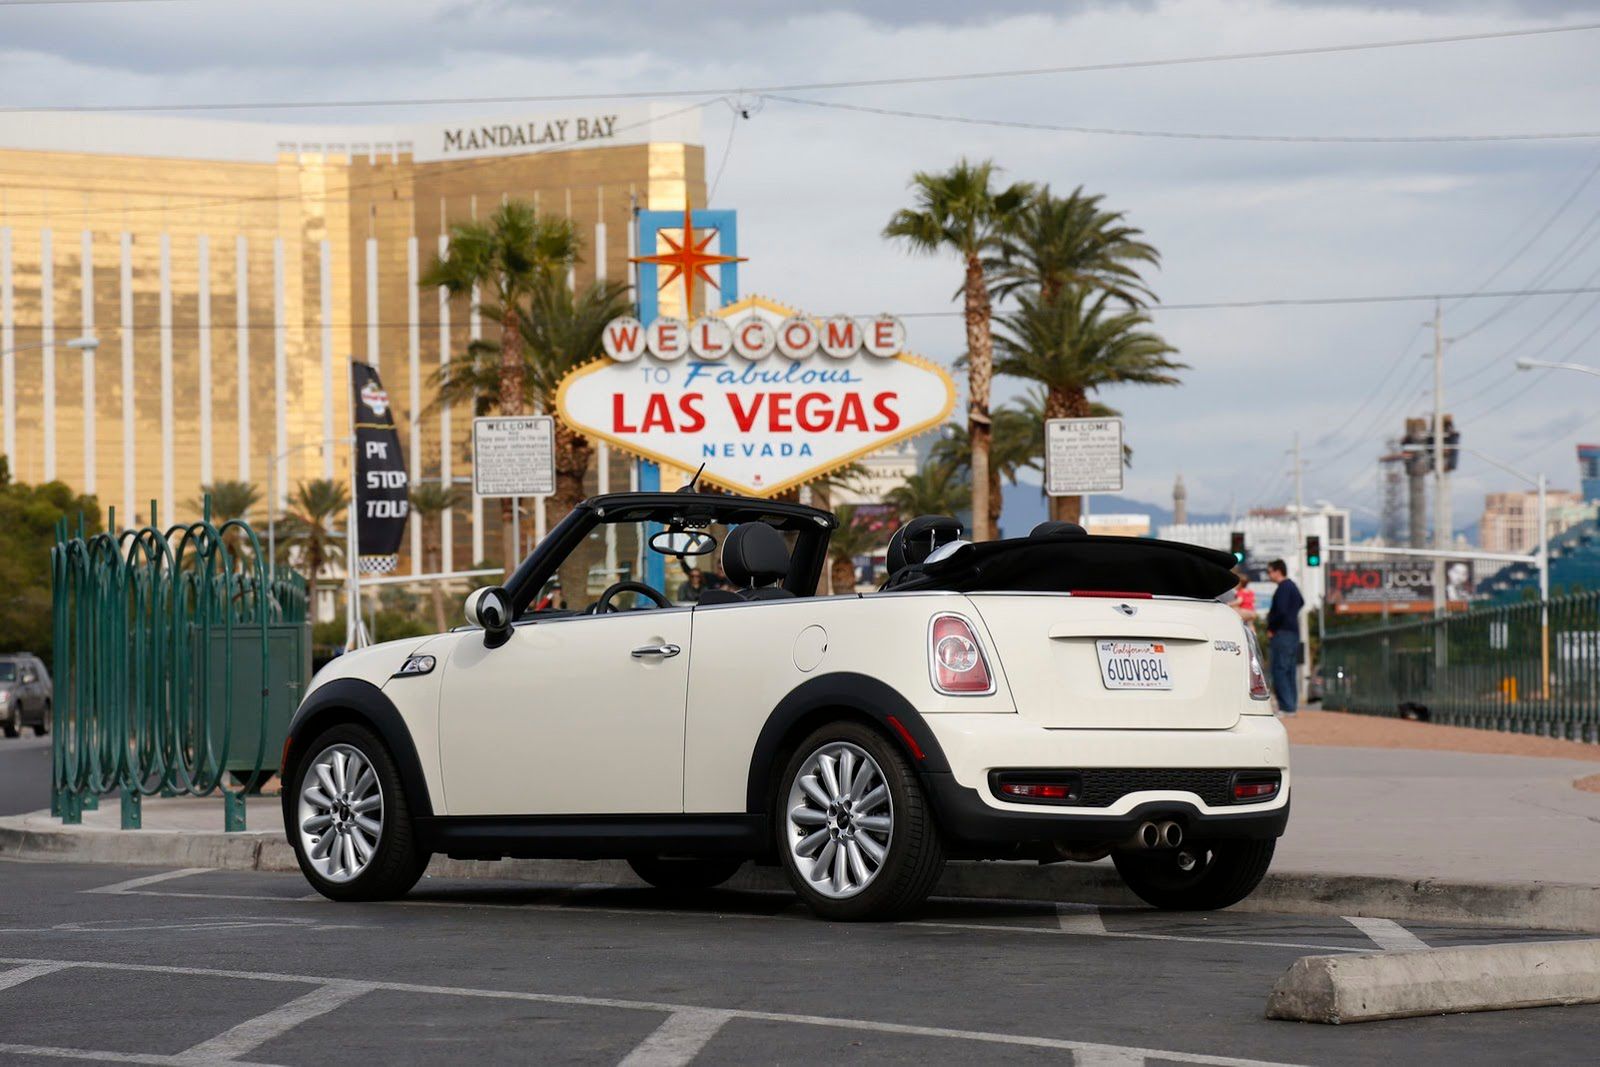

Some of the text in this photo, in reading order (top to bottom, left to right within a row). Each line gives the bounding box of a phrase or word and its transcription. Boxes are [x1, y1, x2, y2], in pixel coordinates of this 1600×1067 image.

[443, 115, 618, 152] MANDALAY BAY
[609, 321, 896, 353] WELCOME
[641, 361, 863, 389] TO Fabulous
[612, 391, 901, 434] LAS VEGAS
[487, 421, 541, 431] WELCOME
[1059, 423, 1110, 432] WELCOME
[703, 442, 813, 458] NEVADA
[366, 470, 408, 489] STOP
[1330, 569, 1380, 591] TAO
[1112, 642, 1155, 658] California
